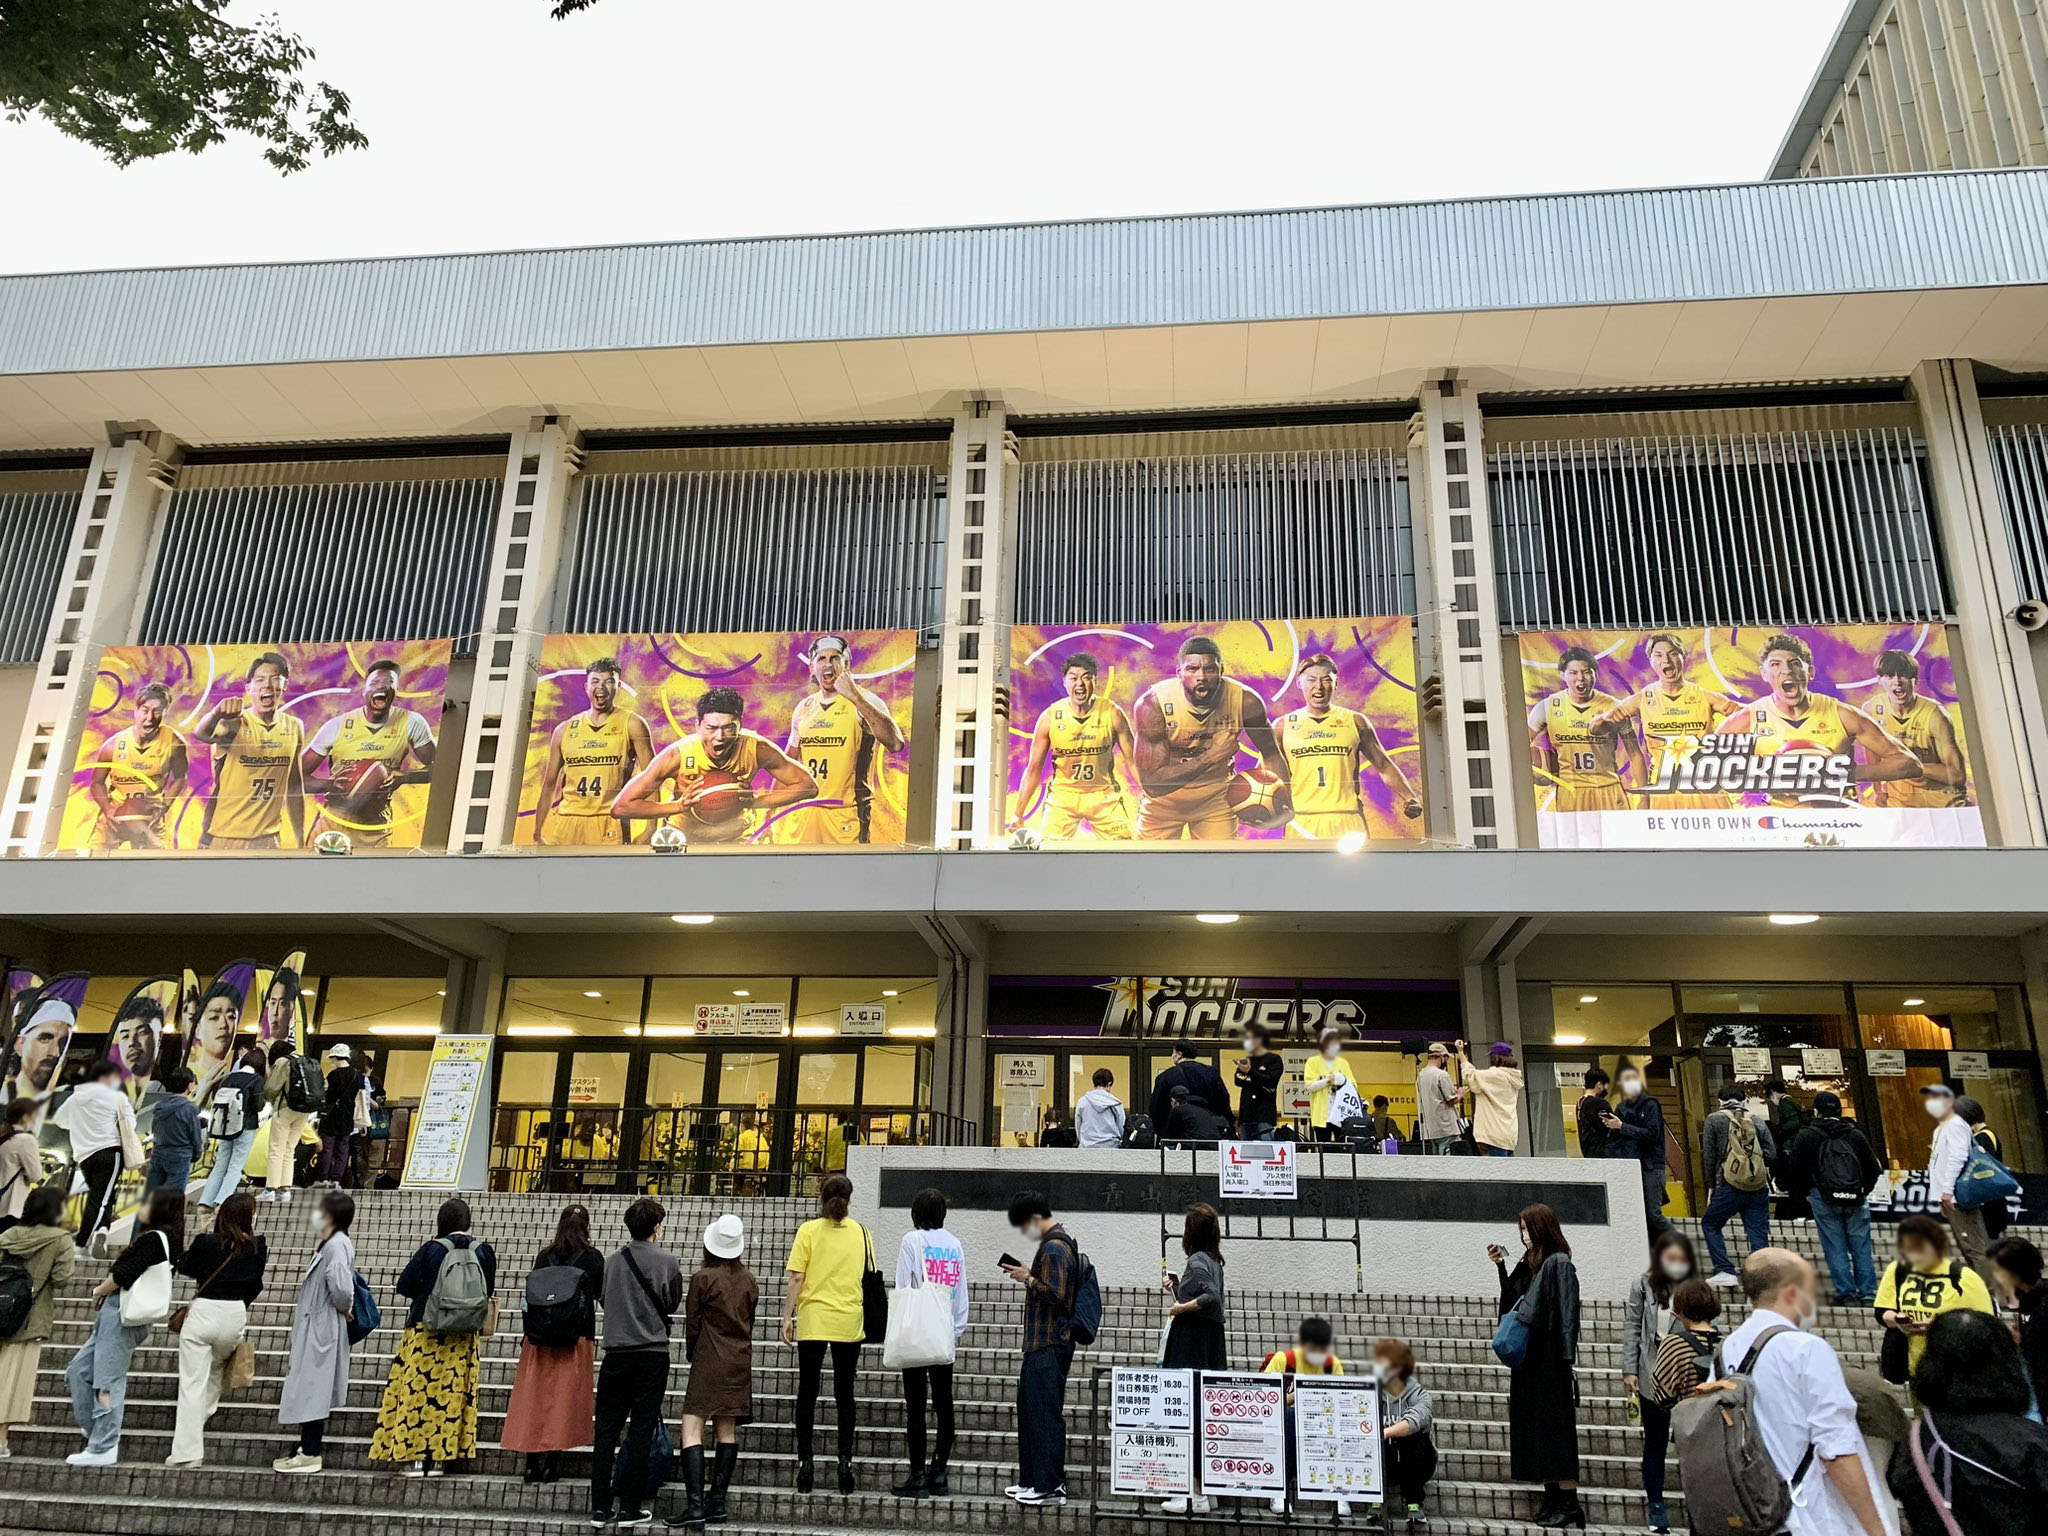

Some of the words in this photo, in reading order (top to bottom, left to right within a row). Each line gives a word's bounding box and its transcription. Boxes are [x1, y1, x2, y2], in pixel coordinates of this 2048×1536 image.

[1054, 744, 1110, 757] SEGASammy
[1291, 744, 1353, 757] SEGASammy
[1702, 733, 1752, 754] SUN
[565, 754, 622, 766] SEGASammy
[1574, 752, 1594, 770] 16
[1640, 735, 1856, 795] ROCKERS
[808, 758, 828, 779] 34
[1071, 764, 1095, 780] 73
[1317, 766, 1326, 787] 1
[251, 778, 276, 801] 75
[576, 776, 602, 797] 44
[1647, 817, 1666, 830] BE
[1671, 817, 1711, 830] YOUR
[1717, 816, 1751, 830] OWN
[1163, 977, 1231, 998] SUN
[1097, 977, 1367, 1040] ROCKERS
[845, 1011, 881, 1021] 入場口
[1901, 1276, 1945, 1309] 28
[1117, 1373, 1158, 1383] 関係者受付
[1163, 1380, 1182, 1388] 16:30
[1117, 1384, 1158, 1394] 当日券販売
[1117, 1396, 1150, 1405] 開場時間
[1164, 1397, 1182, 1405] 17:30
[1117, 1406, 1131, 1415] TIP
[1133, 1407, 1150, 1416] OFF
[1163, 1408, 1182, 1417] 19:05
